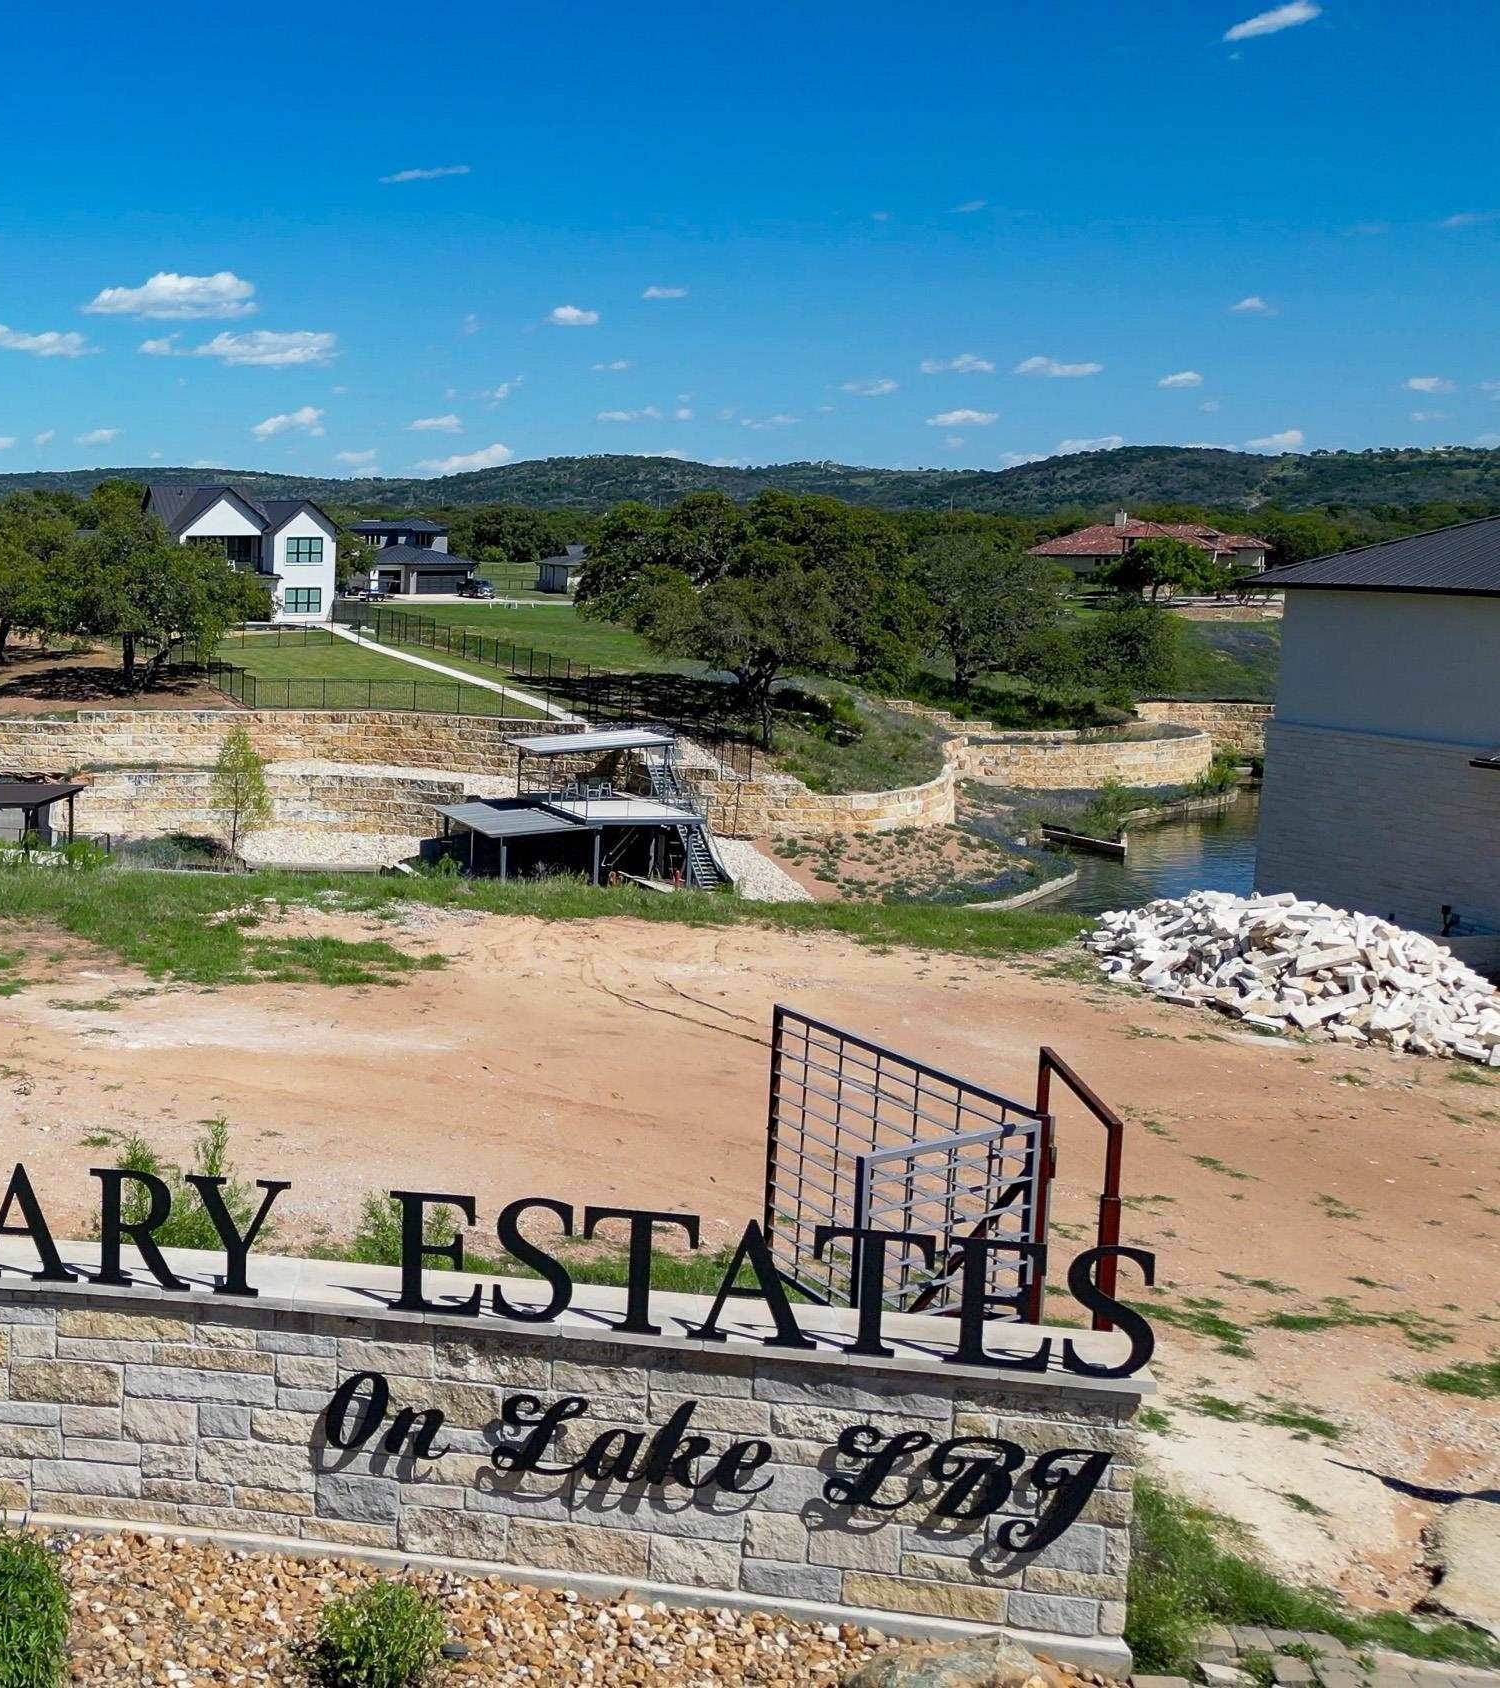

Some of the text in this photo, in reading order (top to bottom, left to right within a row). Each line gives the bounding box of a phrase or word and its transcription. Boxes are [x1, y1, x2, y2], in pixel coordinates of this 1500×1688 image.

[389, 1190, 1155, 1377] ESTATES
[324, 1371, 1112, 1553] On Lake LBJ
